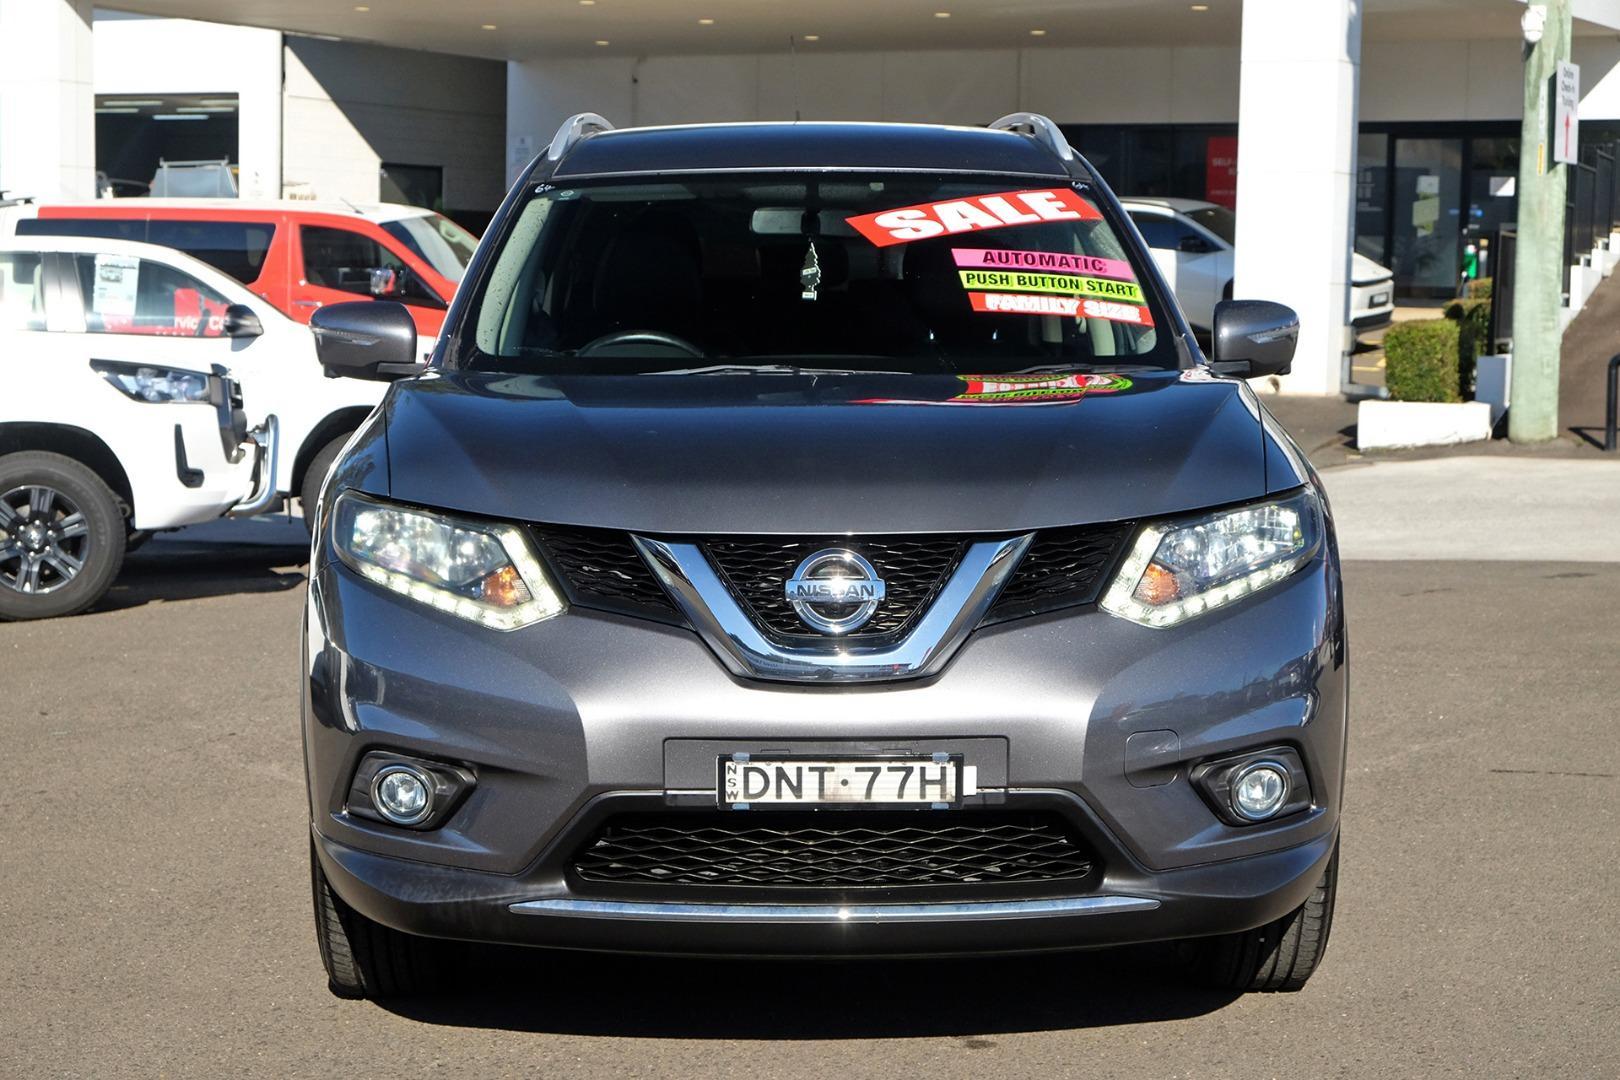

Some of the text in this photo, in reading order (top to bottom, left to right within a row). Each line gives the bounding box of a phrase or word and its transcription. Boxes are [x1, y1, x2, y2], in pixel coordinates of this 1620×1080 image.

[874, 191, 1081, 240] SALE
[982, 250, 1108, 273] AUTOMATIC
[965, 272, 1136, 298] PUSH BUTTON START
[984, 293, 1142, 323] FAMILY SIZE
[727, 765, 739, 801] NSW
